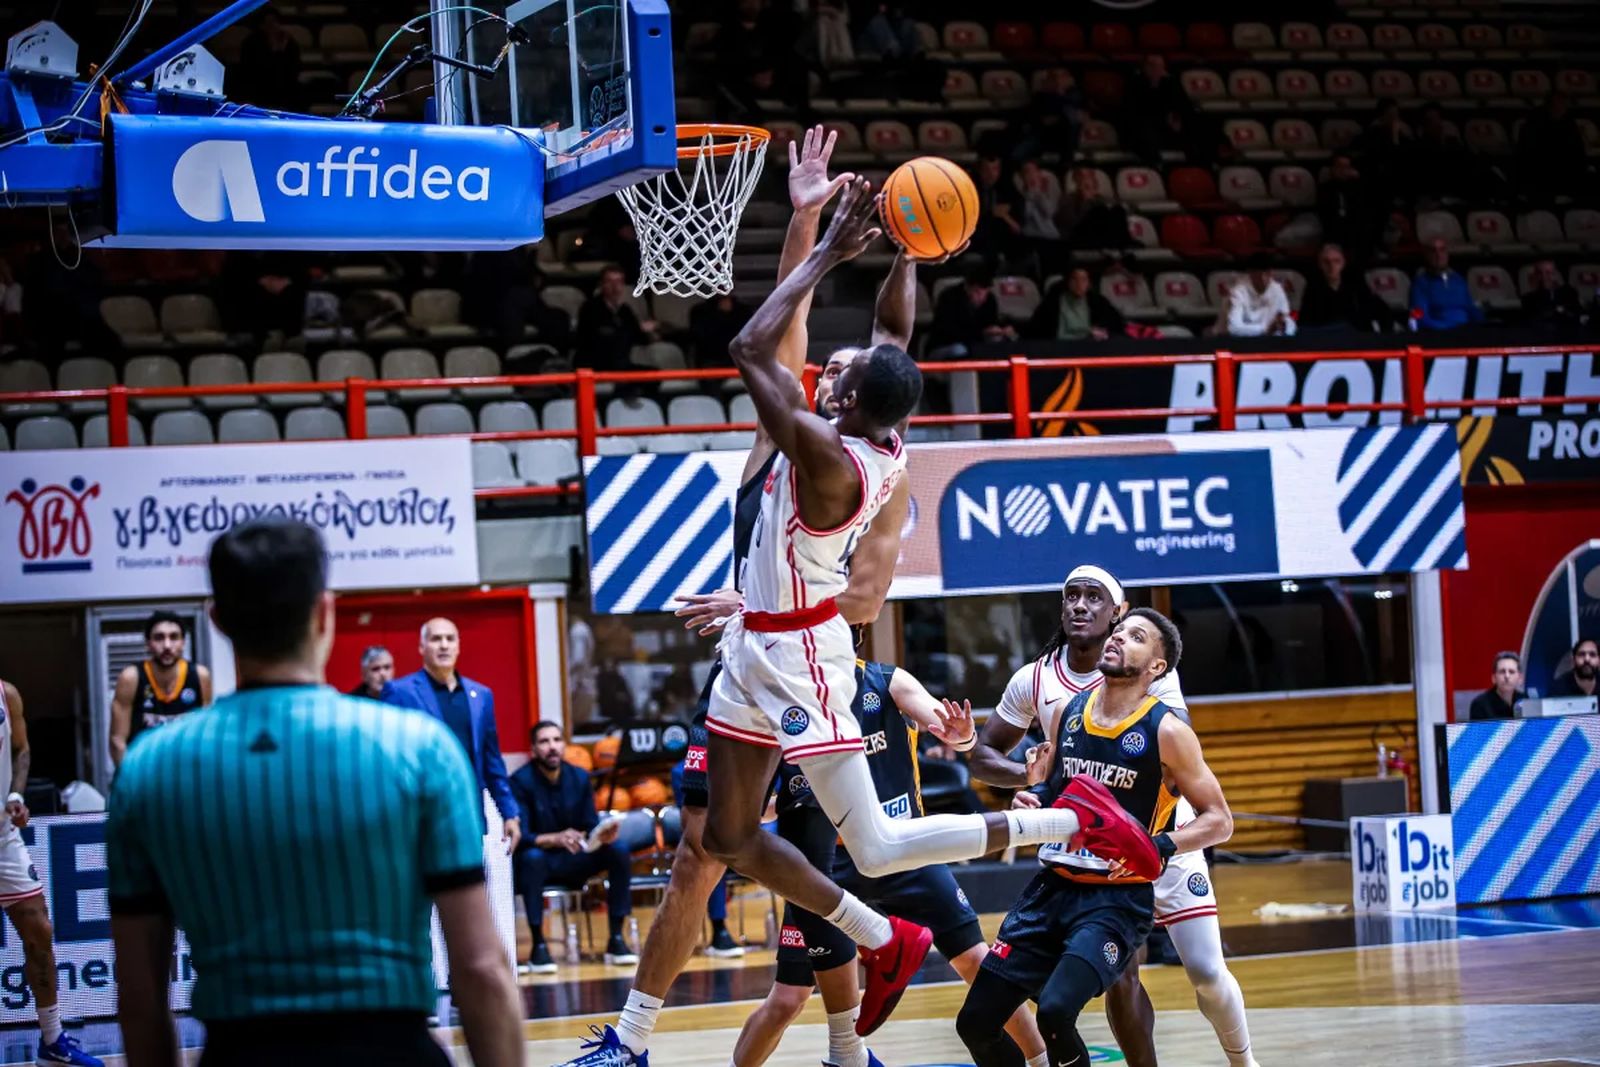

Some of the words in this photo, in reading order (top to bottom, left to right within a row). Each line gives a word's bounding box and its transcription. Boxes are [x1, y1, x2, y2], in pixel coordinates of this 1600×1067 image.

[276, 145, 490, 201] affidea
[955, 476, 1233, 541] NOVATEC
[1134, 531, 1236, 556] engineering
[1412, 874, 1450, 908] job
